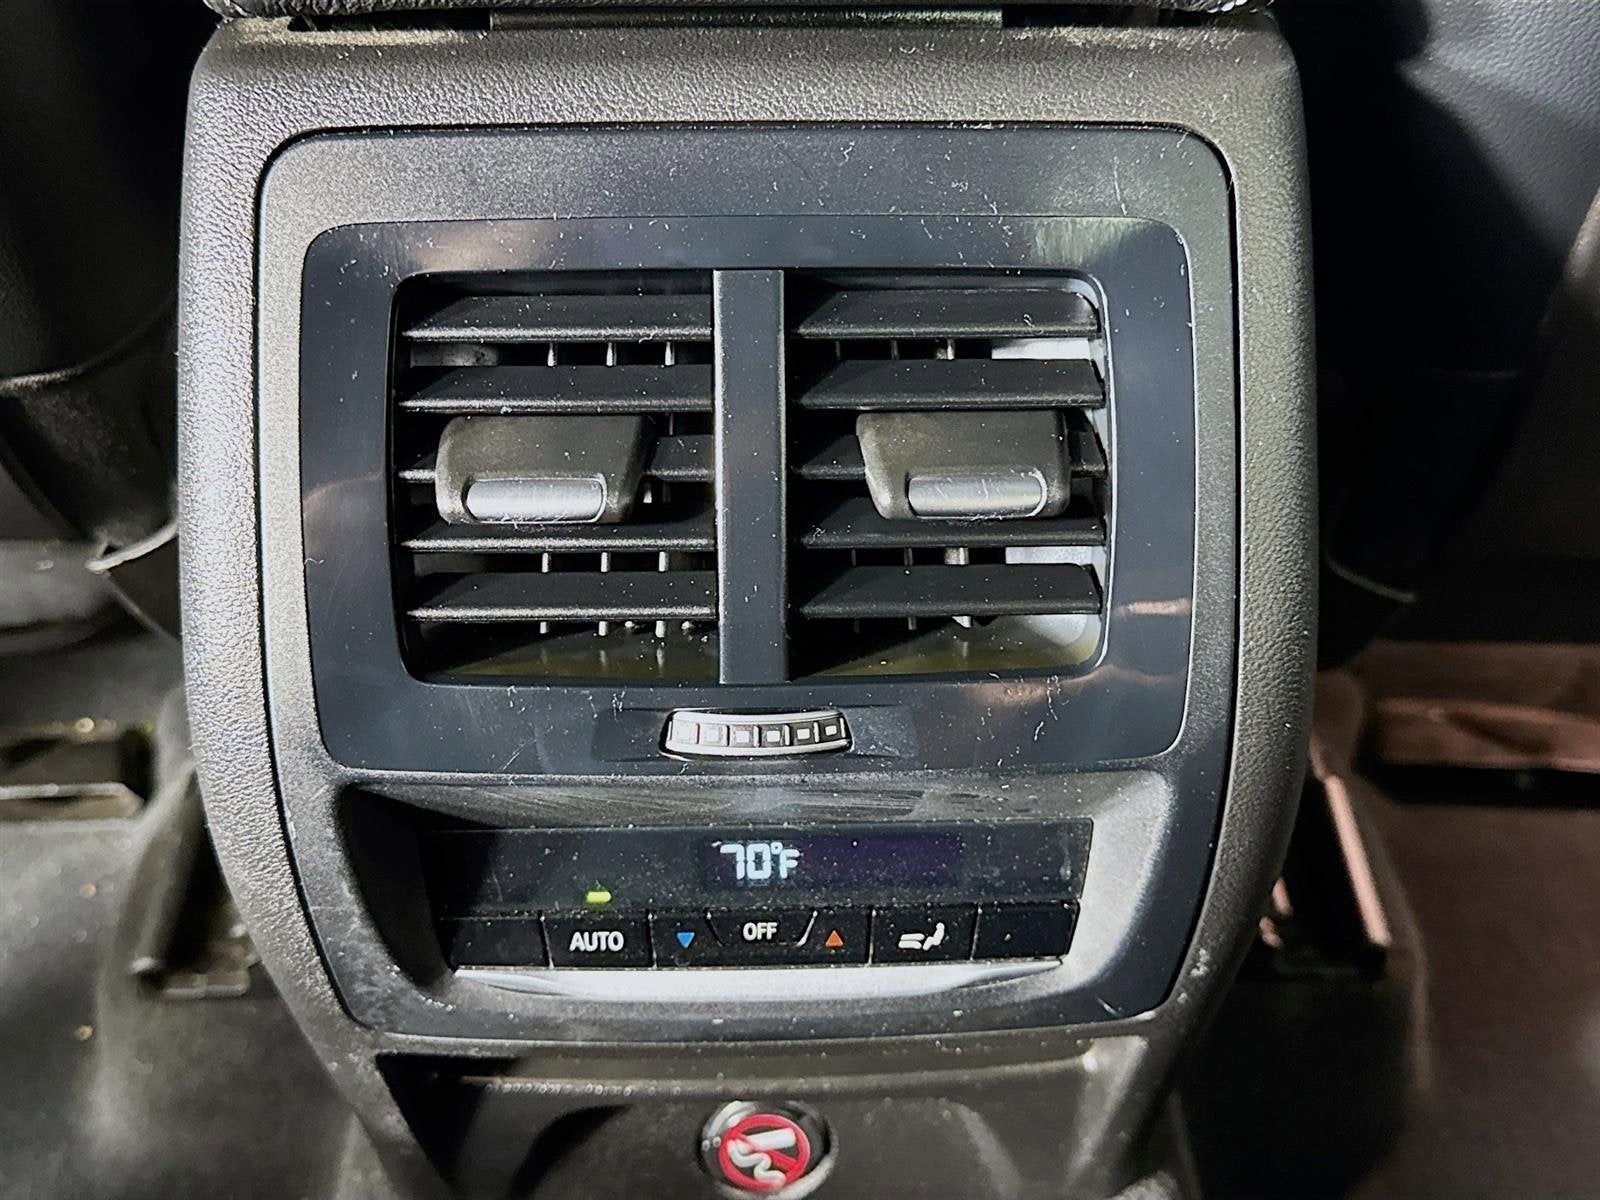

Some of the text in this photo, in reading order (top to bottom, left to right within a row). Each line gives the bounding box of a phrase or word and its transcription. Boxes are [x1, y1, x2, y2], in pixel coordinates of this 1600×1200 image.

[719, 841, 800, 880] 70°F
[569, 930, 624, 952] AUTO
[742, 922, 778, 941] OFF
